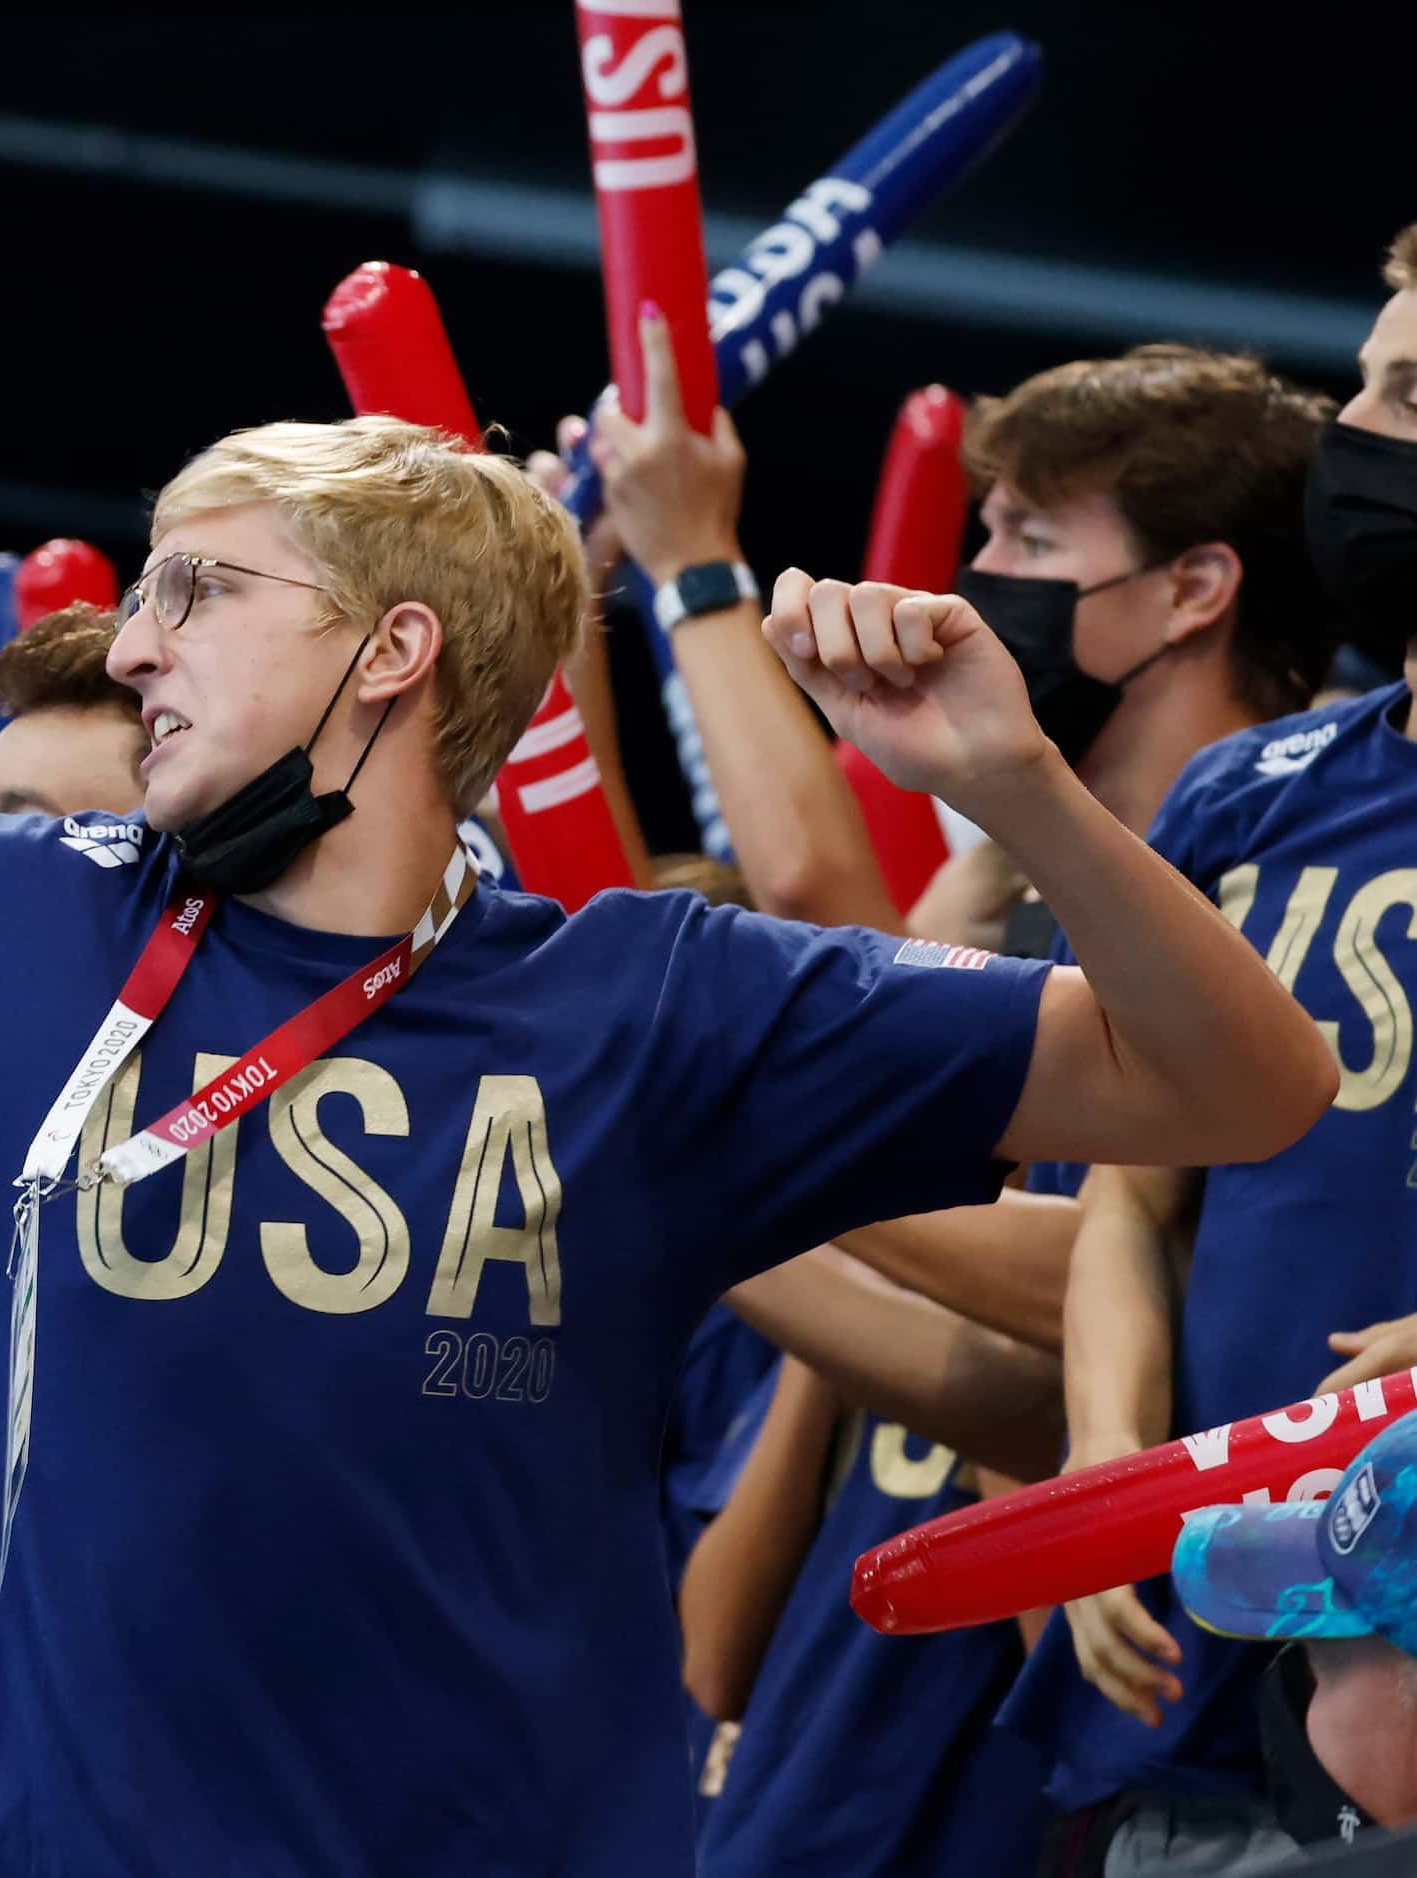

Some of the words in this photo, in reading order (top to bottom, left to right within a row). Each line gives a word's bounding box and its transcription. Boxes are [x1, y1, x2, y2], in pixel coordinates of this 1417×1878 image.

[573, 0, 698, 192] US
[1262, 721, 1338, 761] arena
[63, 816, 144, 847] arena
[171, 897, 205, 936] Atos
[362, 955, 403, 1000] Atos
[63, 1056, 112, 1111] TOKYO
[97, 1019, 139, 1056] 2020
[210, 1056, 279, 1114] TOKYO
[168, 1101, 219, 1143] 2020
[75, 1051, 564, 1327] USA
[422, 1329, 557, 1404] 2020
